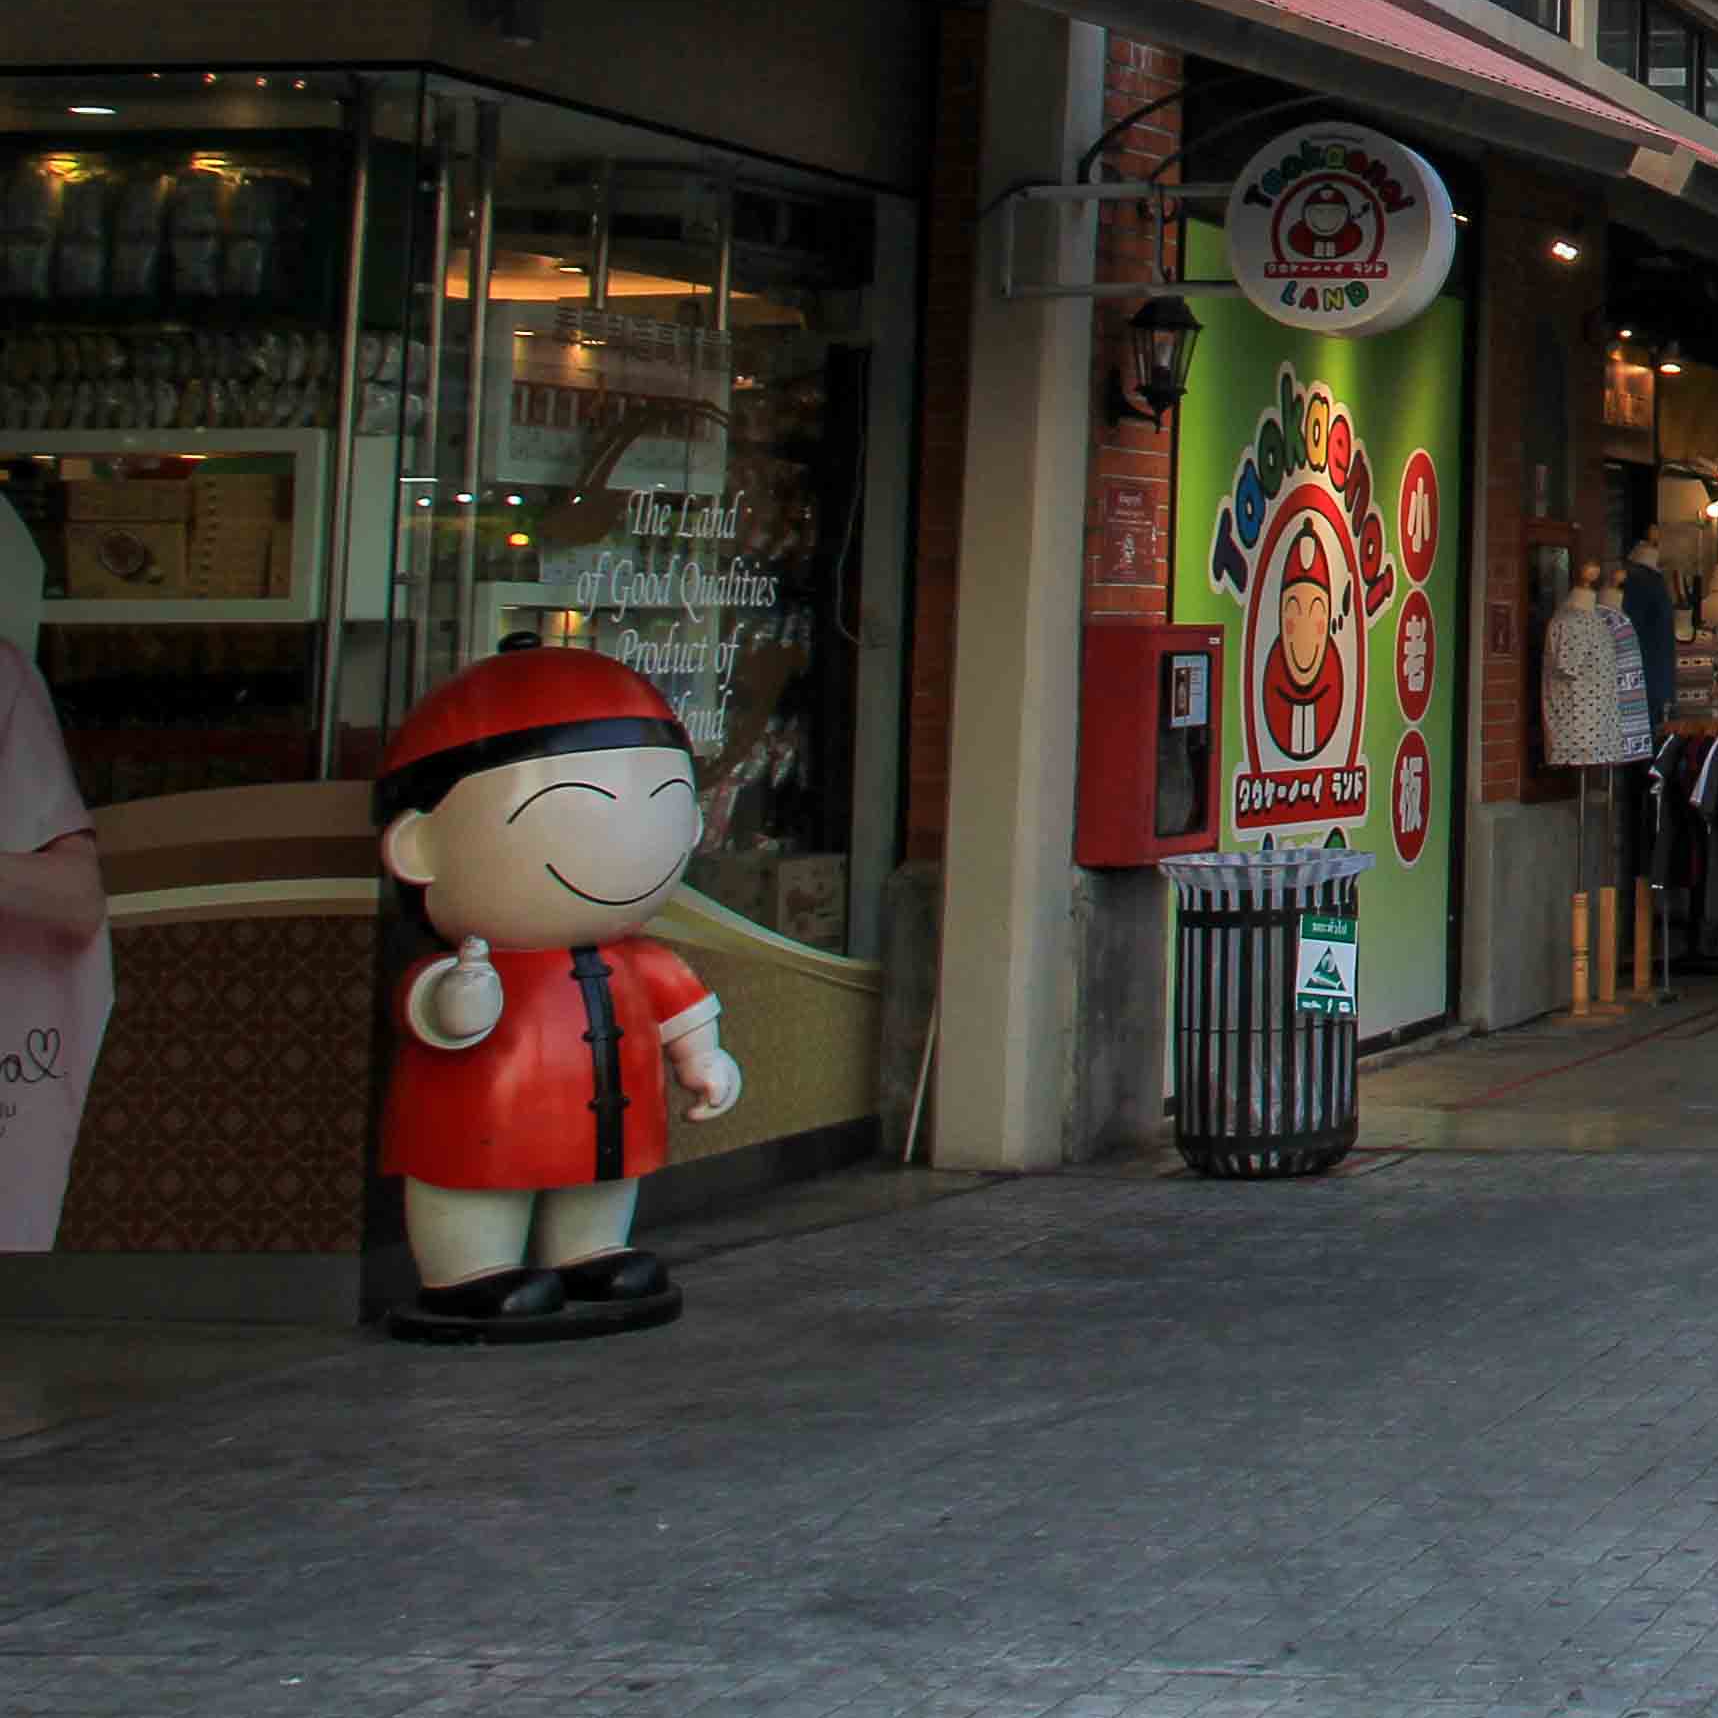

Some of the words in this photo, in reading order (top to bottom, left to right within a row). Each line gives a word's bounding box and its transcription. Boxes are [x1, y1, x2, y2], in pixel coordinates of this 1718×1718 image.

[1279, 280, 1370, 312] LAND
[628, 489, 672, 537] The
[677, 490, 745, 539] Land
[576, 550, 612, 622] of
[610, 553, 681, 624] Good
[679, 556, 780, 625] Qualities
[616, 620, 710, 676] Product
[714, 622, 745, 691] of
